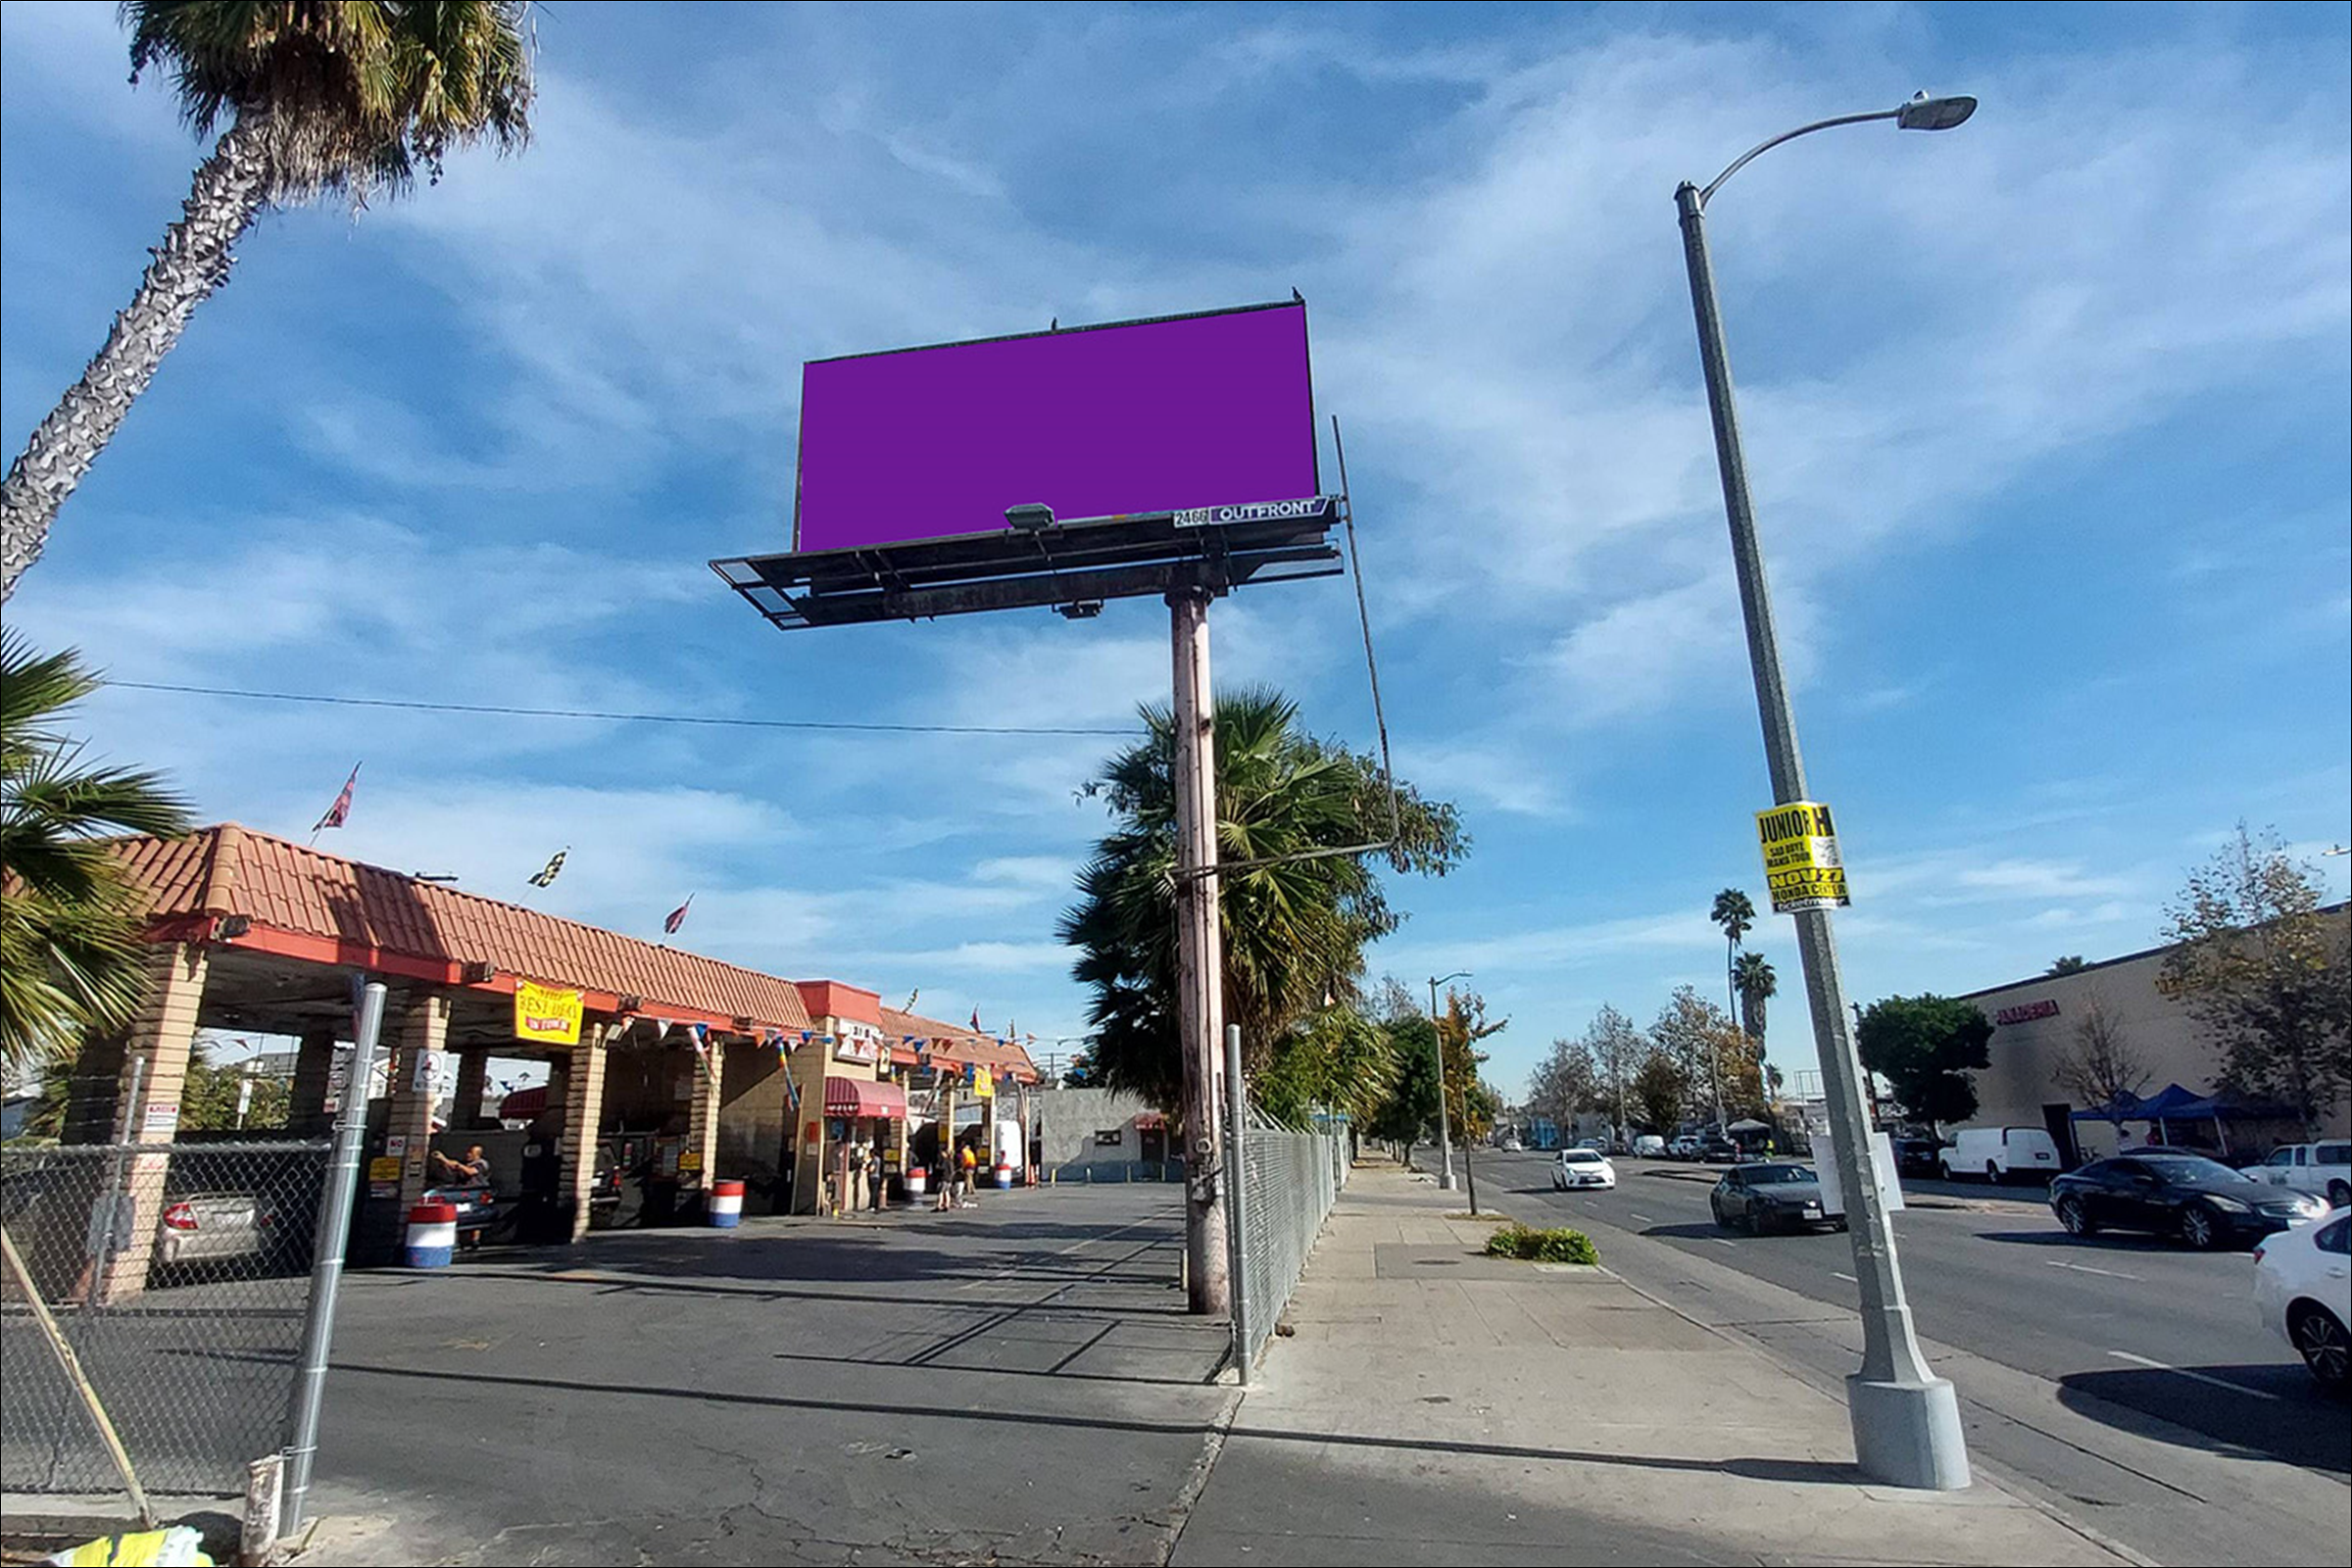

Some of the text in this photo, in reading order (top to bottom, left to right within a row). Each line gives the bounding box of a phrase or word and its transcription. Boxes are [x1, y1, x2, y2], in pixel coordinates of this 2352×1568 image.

[1219, 501, 1316, 521] OUTFRONT
[1758, 807, 1835, 844] JUNIOR H
[1770, 868, 1842, 888] NOV 27
[1772, 883, 1846, 901] HONDA CENTER
[519, 995, 549, 1013] BEST
